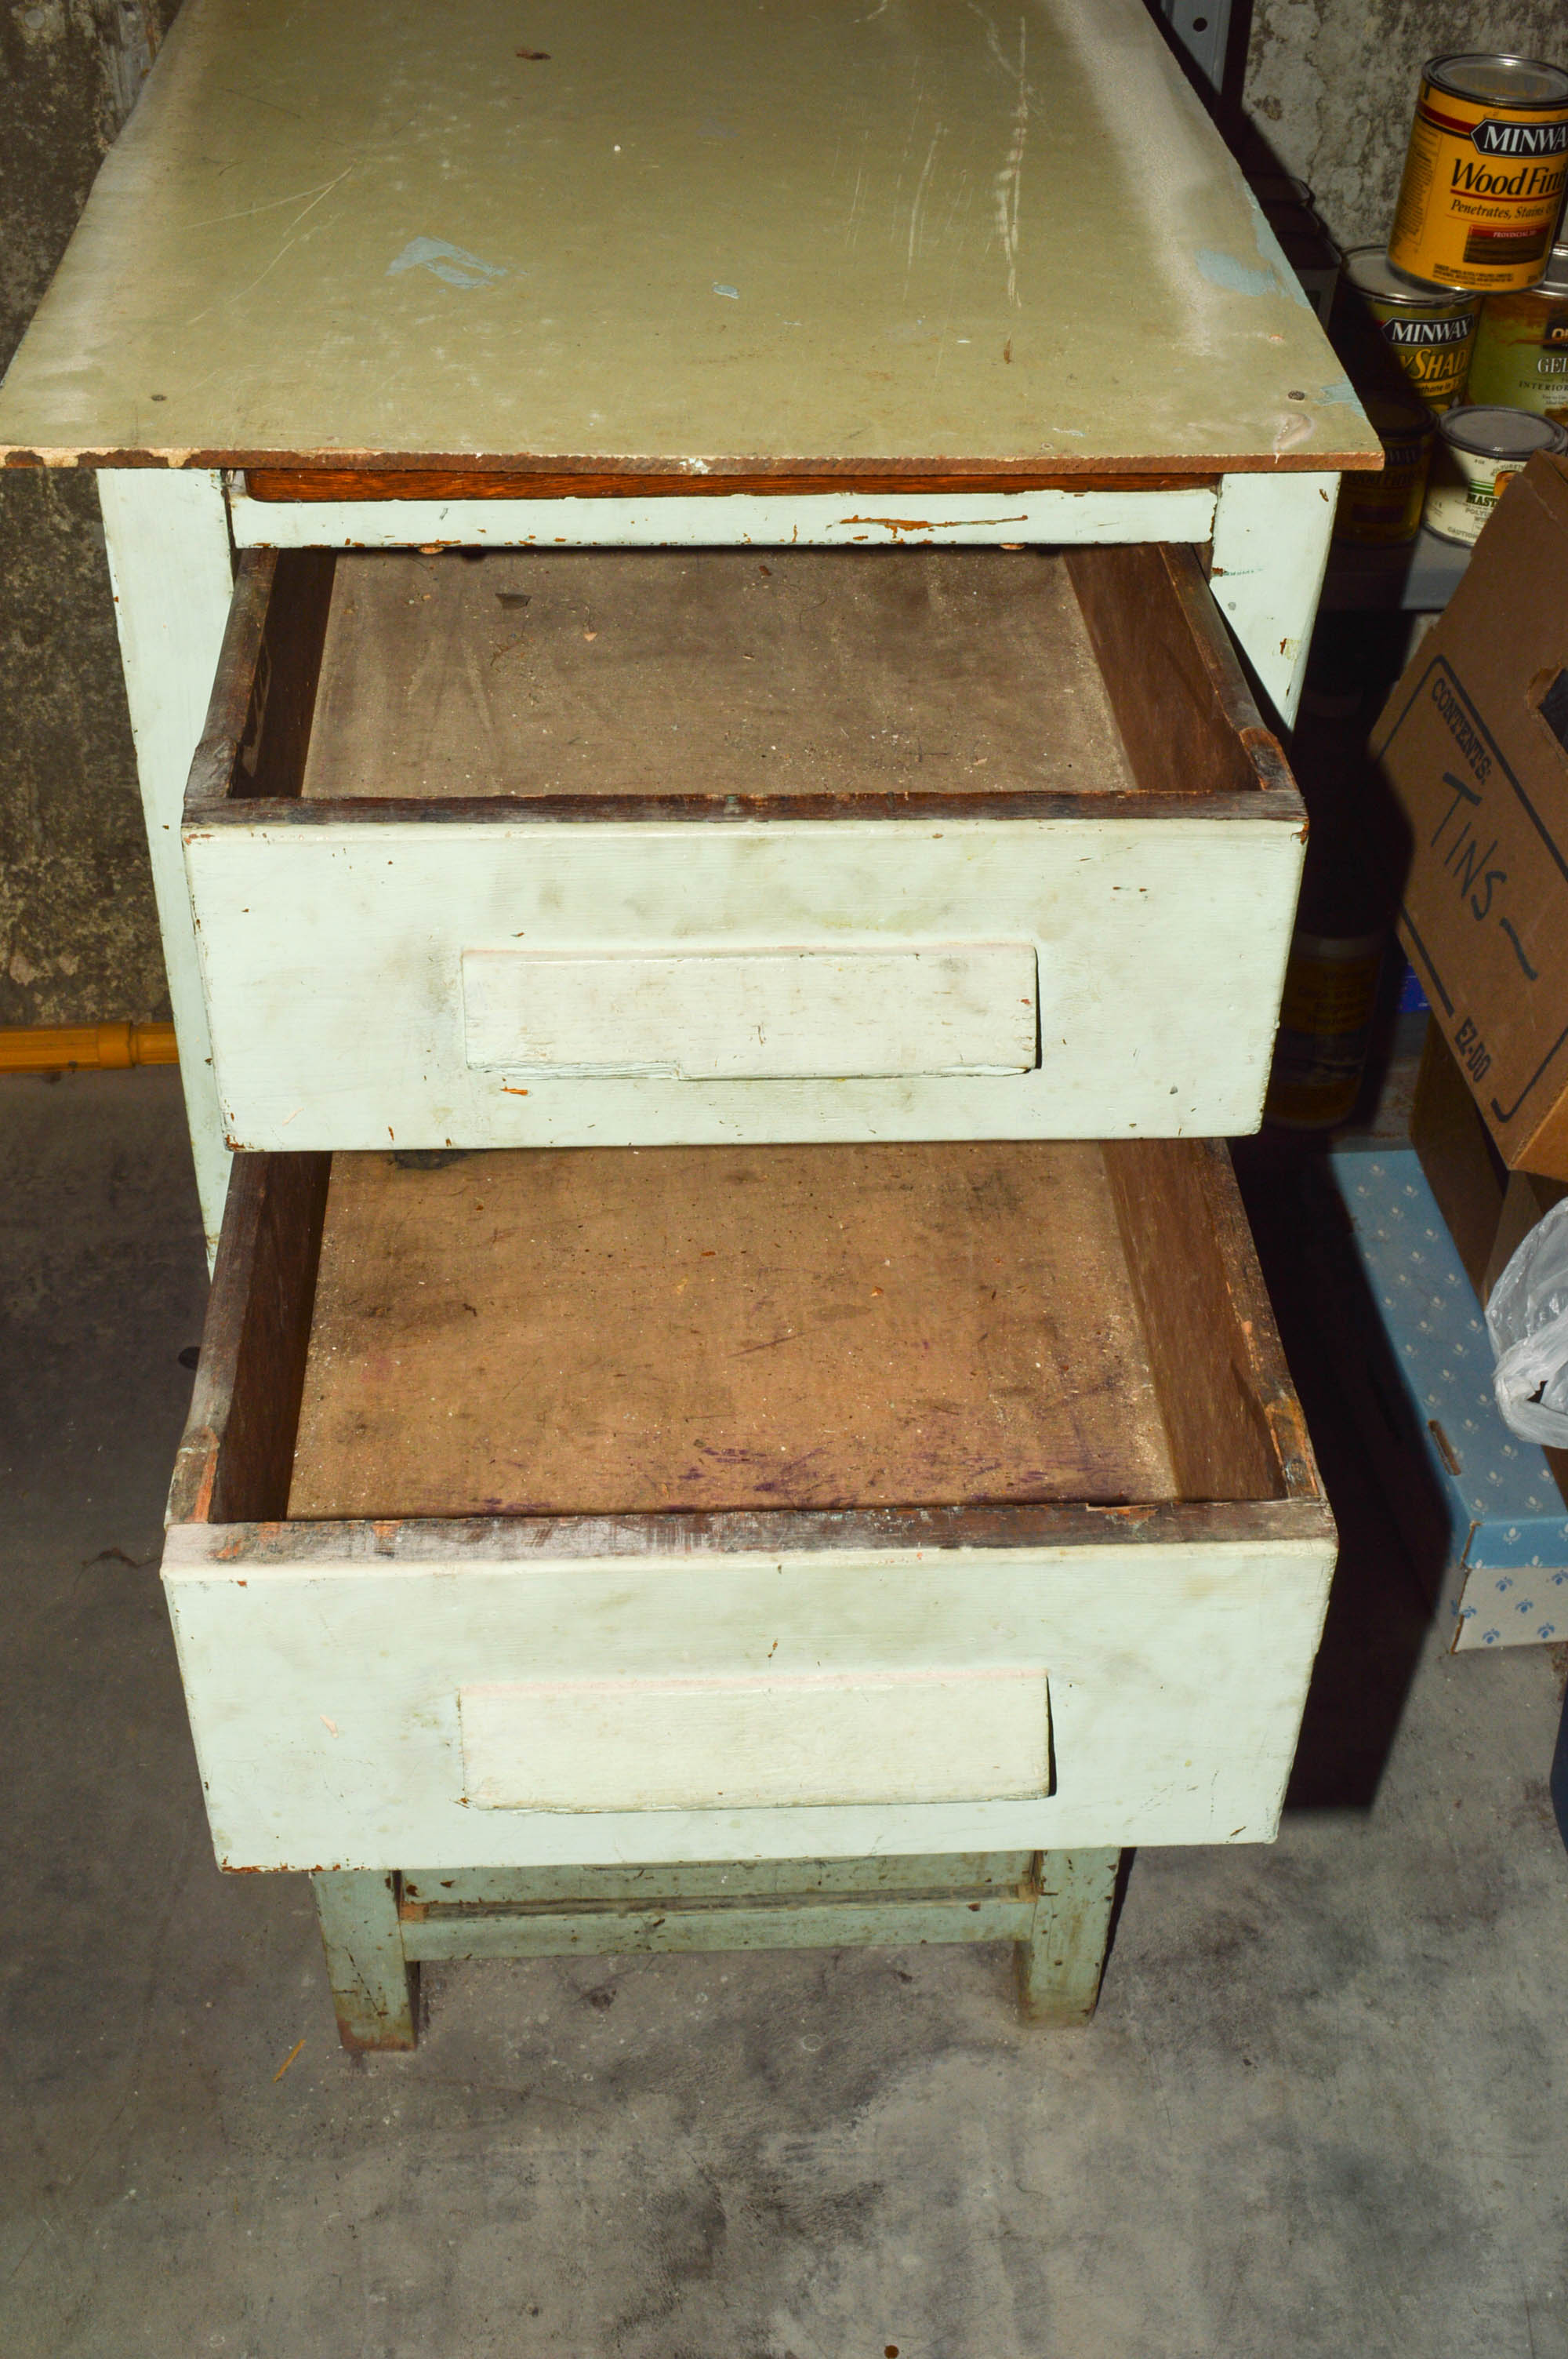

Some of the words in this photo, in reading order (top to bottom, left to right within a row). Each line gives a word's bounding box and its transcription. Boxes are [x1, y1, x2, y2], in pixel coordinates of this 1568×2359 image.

[1483, 125, 1568, 152] MINWA
[1451, 158, 1528, 195] Wood
[1526, 162, 1568, 195] Fini
[1450, 199, 1512, 220] Penetrates,
[1392, 318, 1470, 343] MINWAX
[1466, 493, 1499, 507] MAST
[1431, 771, 1507, 921] TINS
